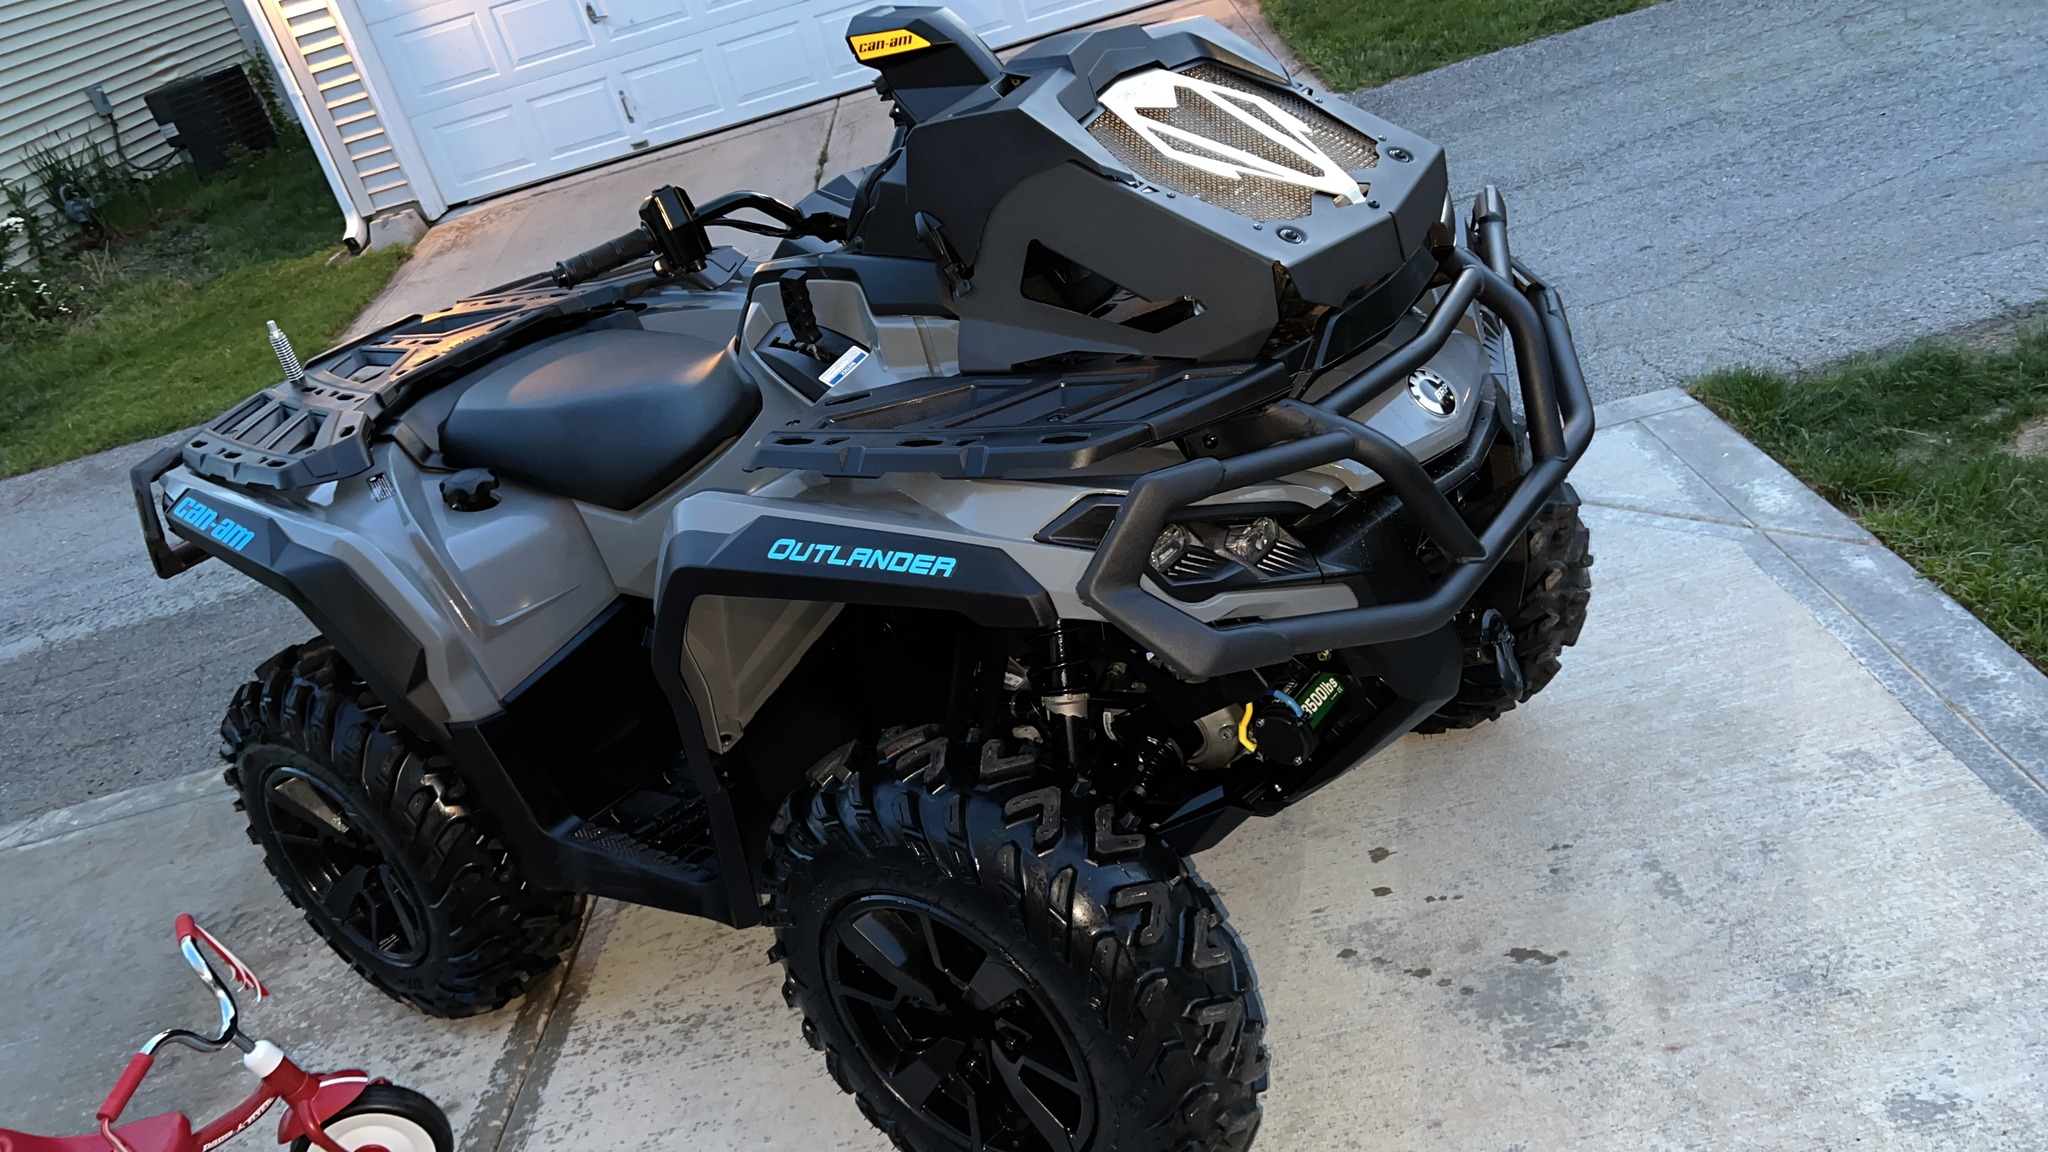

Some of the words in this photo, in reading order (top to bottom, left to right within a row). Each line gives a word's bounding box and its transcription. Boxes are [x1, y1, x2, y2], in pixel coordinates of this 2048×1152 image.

[859, 35, 912, 53] can-am
[1434, 383, 1448, 401] BRP
[174, 496, 255, 552] can-am
[767, 538, 957, 578] OUTLANDER
